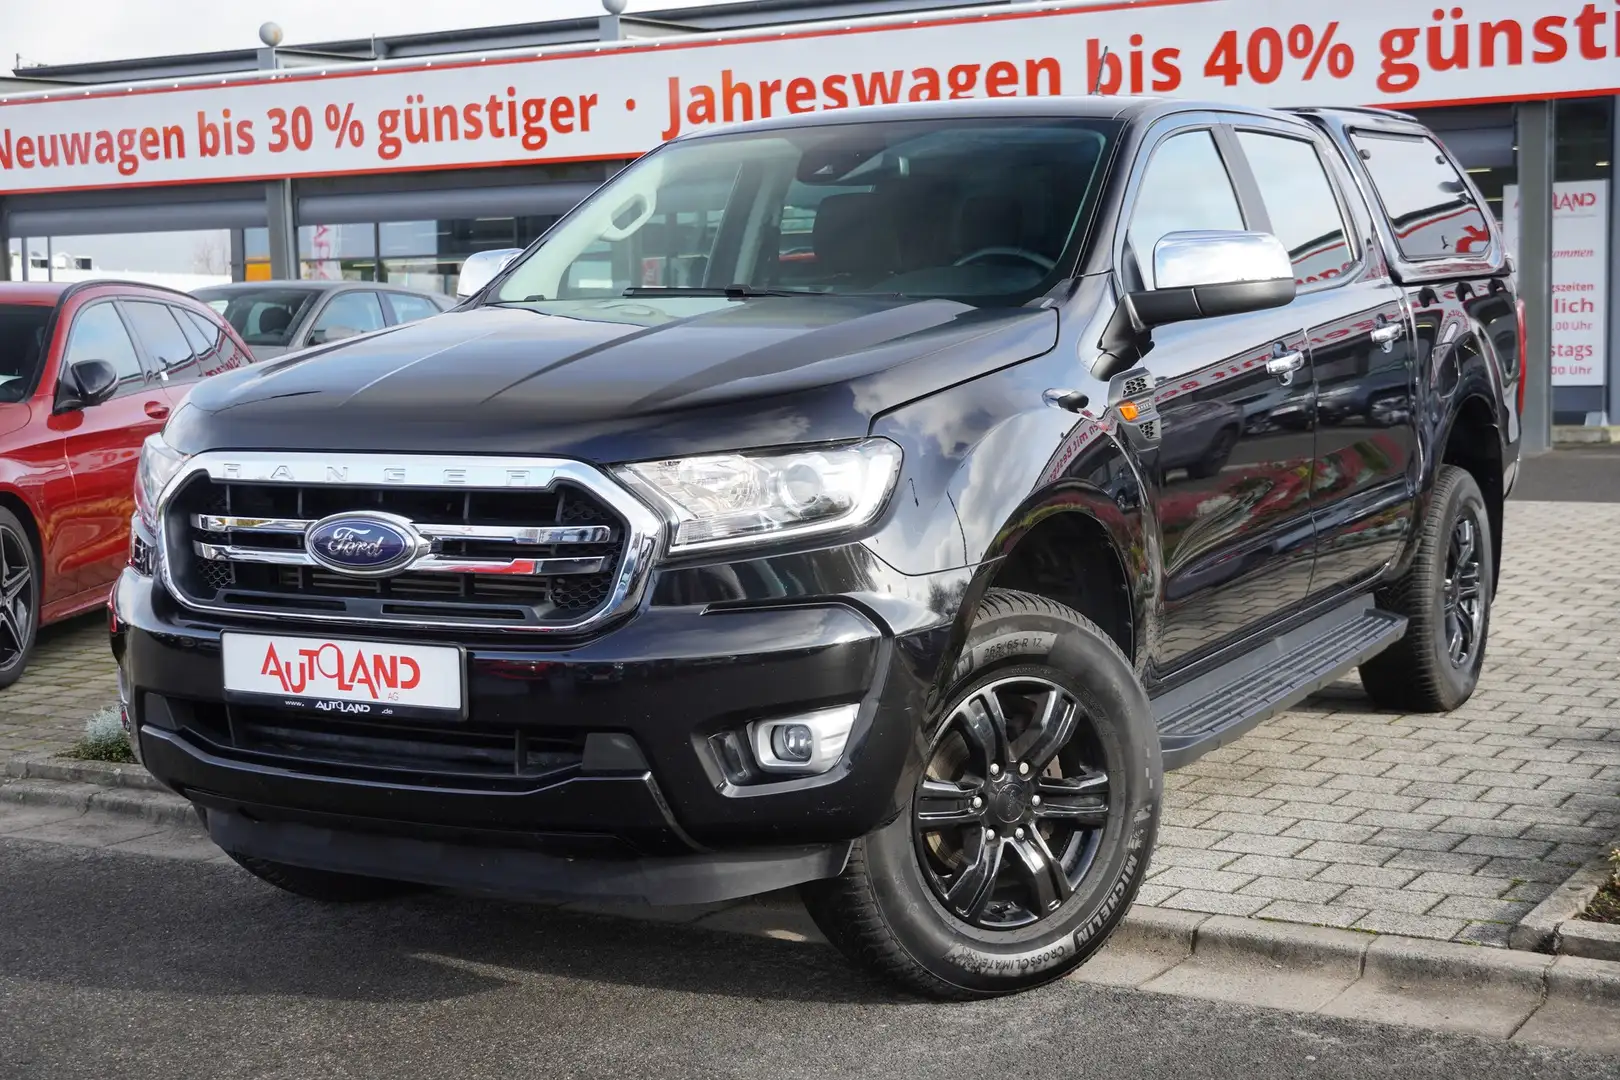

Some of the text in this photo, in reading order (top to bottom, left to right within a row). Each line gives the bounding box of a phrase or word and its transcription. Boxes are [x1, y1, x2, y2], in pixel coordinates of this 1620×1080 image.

[0, 125, 185, 176] Neuwagen
[197, 108, 256, 157] bis
[266, 105, 313, 153] 30
[324, 102, 365, 149] %
[376, 85, 599, 161] günstiger
[661, 56, 1061, 141] Jahreswagen
[1086, 33, 1182, 96] bis
[1203, 21, 1355, 87] 40%
[1553, 297, 1594, 313] lich
[1571, 319, 1593, 331] Uhr
[1550, 343, 1593, 361] stags
[1569, 364, 1592, 375] Uhr
[223, 463, 531, 486] RANGER
[327, 526, 385, 558] Ford
[261, 641, 421, 699] AUTOLAND
[315, 700, 371, 713] AUTOLAND
[1076, 853, 1139, 946] MICHELIN
[980, 945, 1065, 971] CROSSCLIMATE
